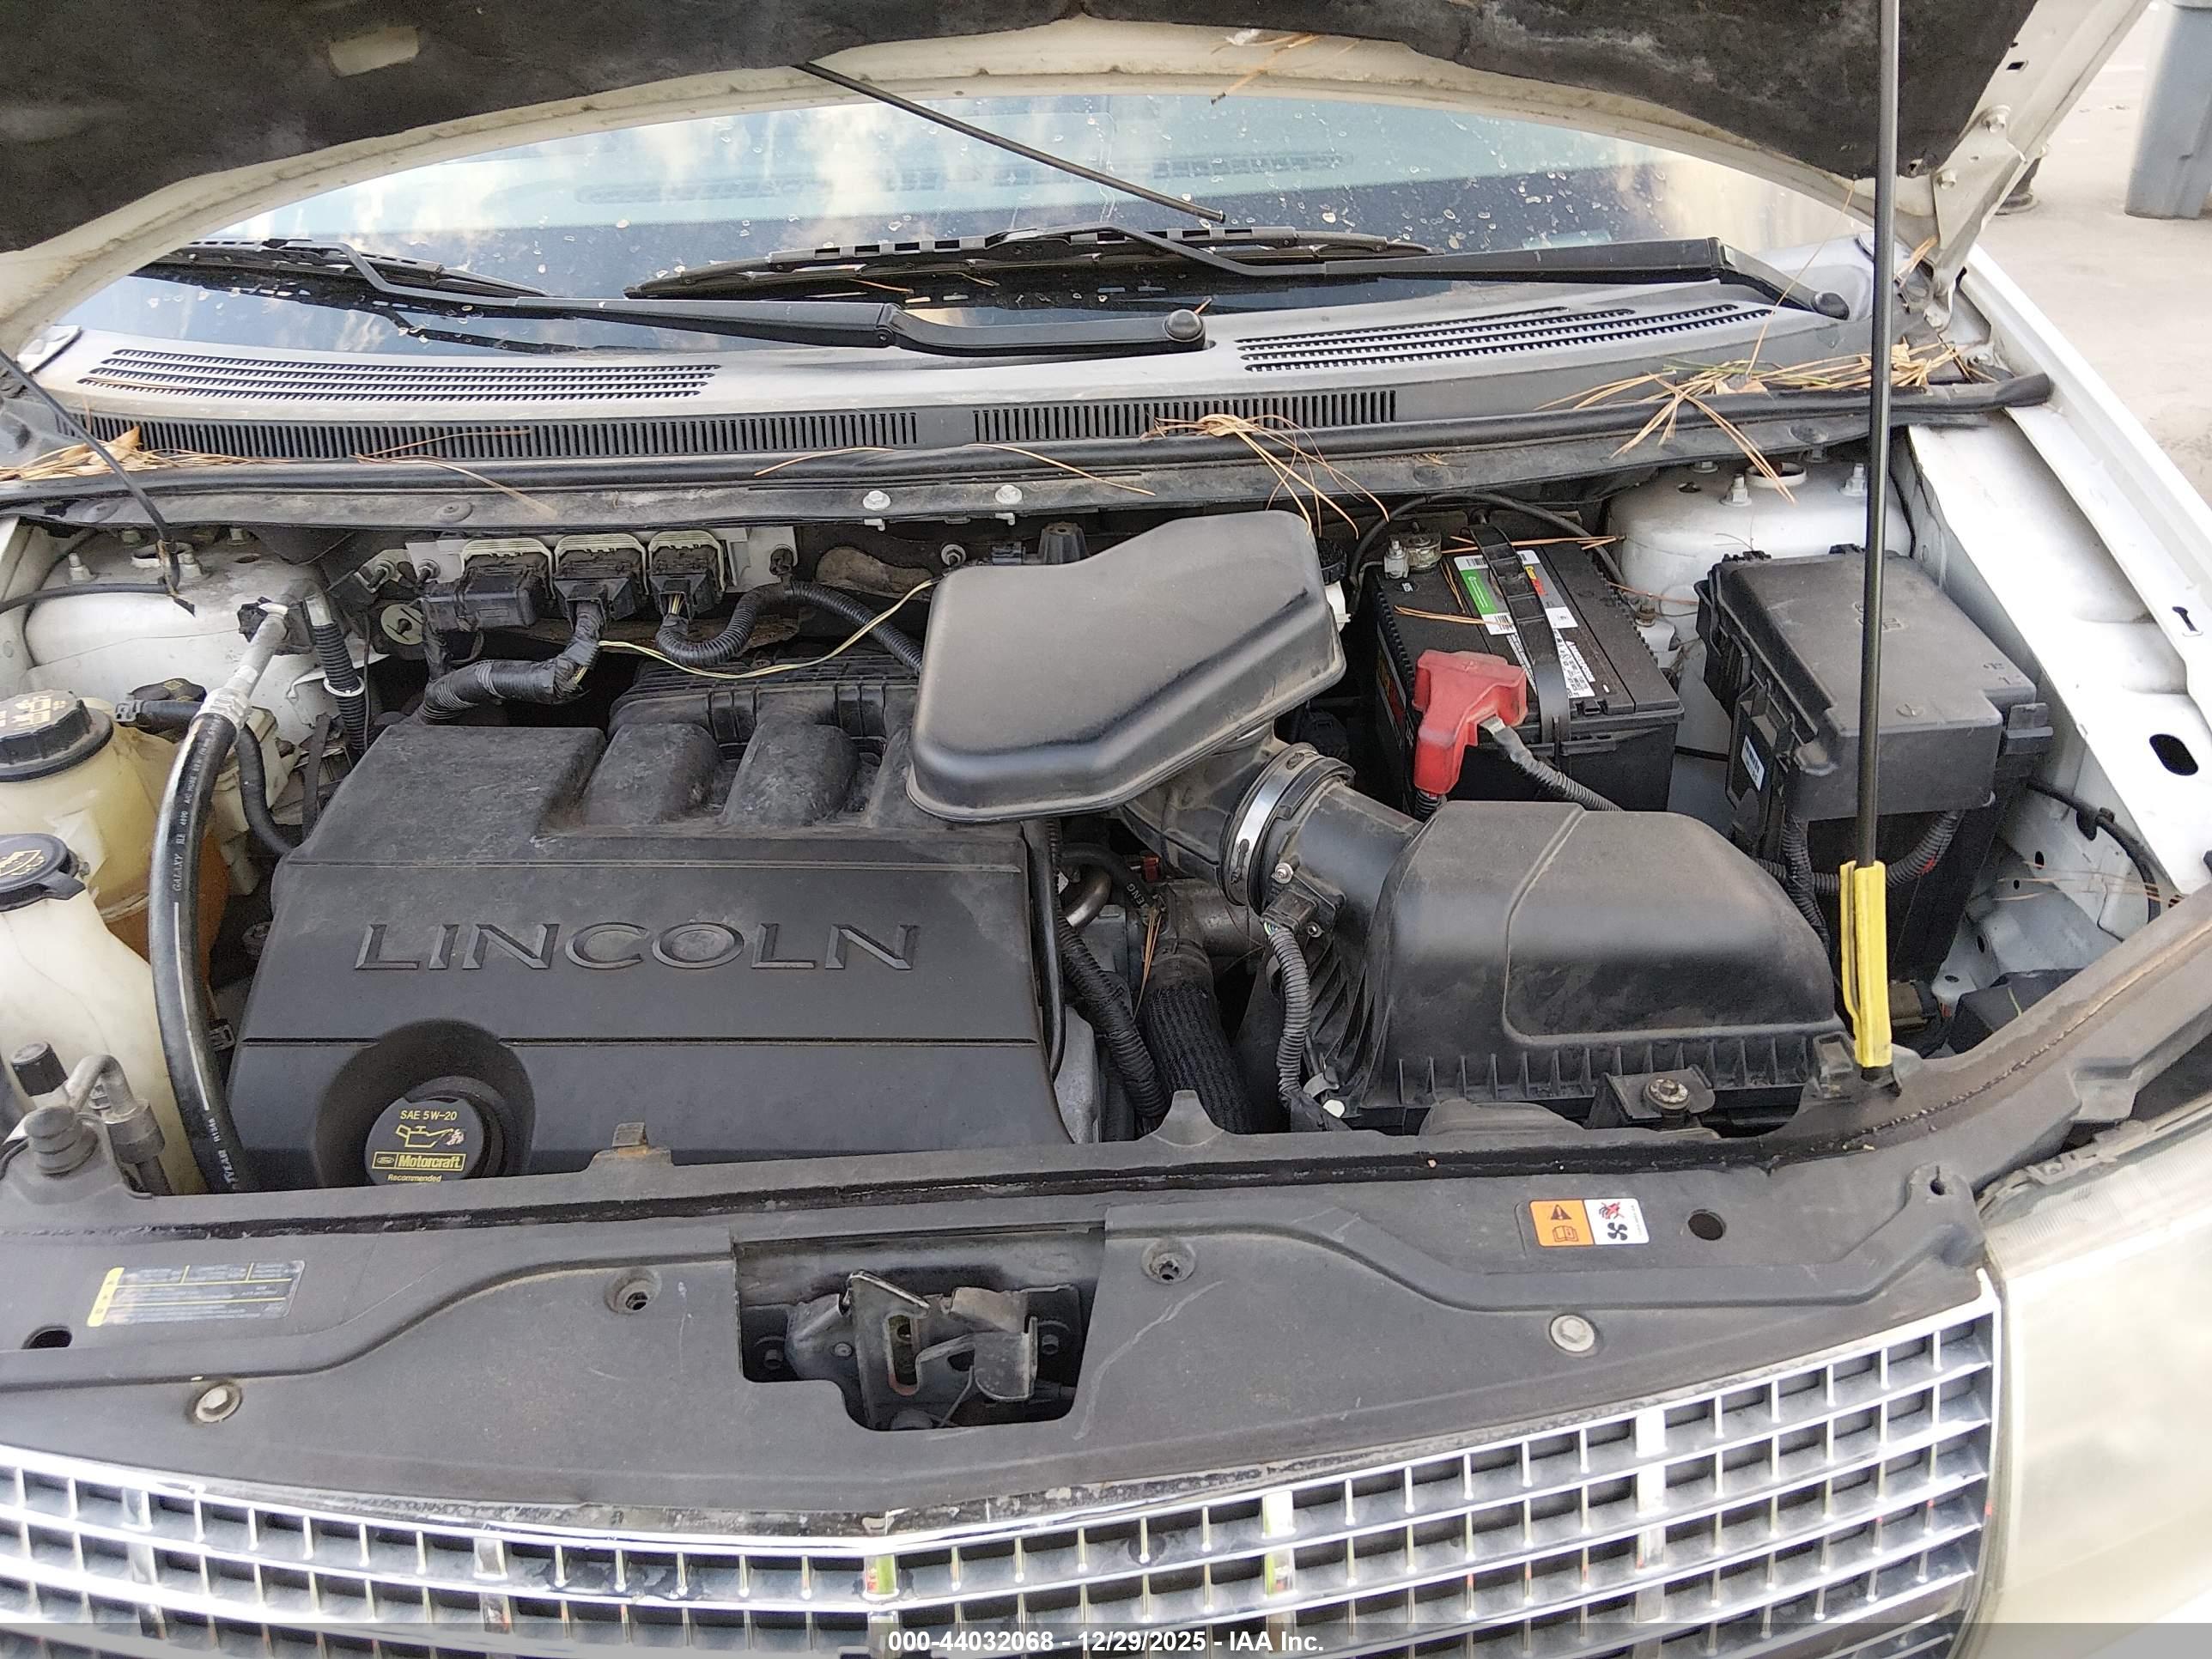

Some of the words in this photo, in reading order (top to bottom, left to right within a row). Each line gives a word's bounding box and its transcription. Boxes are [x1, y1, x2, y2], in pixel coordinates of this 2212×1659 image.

[354, 922, 920, 970] LINCOLN
[399, 1109, 421, 1120] SAE
[422, 1110, 458, 1121] 5W-20
[397, 1154, 461, 1169] Motorcraft
[387, 1173, 442, 1182] Recommended
